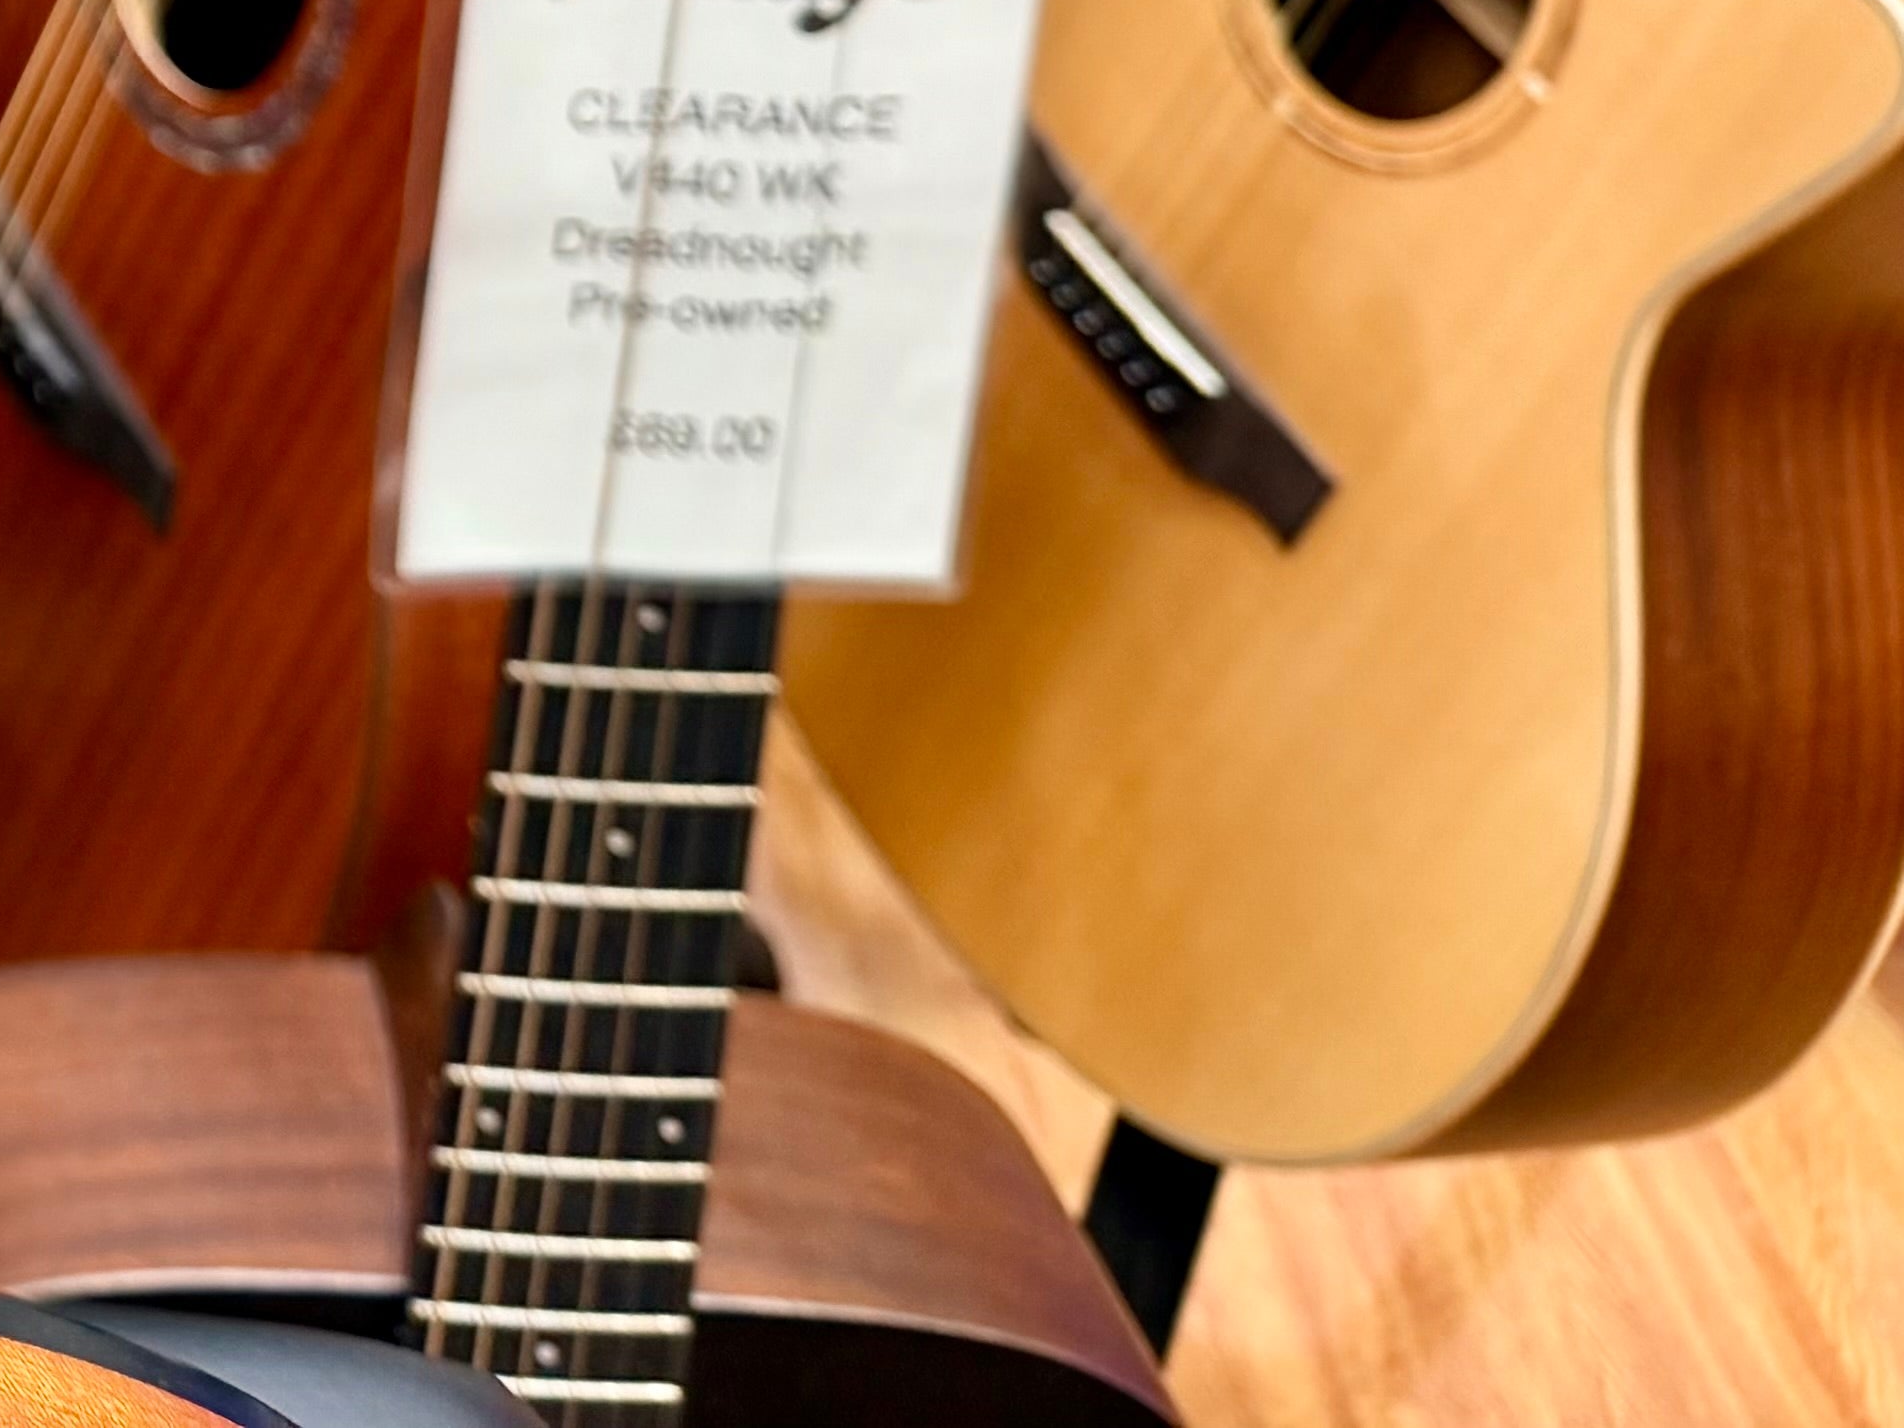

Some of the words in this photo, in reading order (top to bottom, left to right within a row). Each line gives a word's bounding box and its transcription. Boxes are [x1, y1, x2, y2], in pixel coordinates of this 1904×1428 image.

[566, 87, 901, 142] CLEARANCE
[552, 215, 869, 281] Dreadnought
[566, 280, 833, 334] Pre-owned
